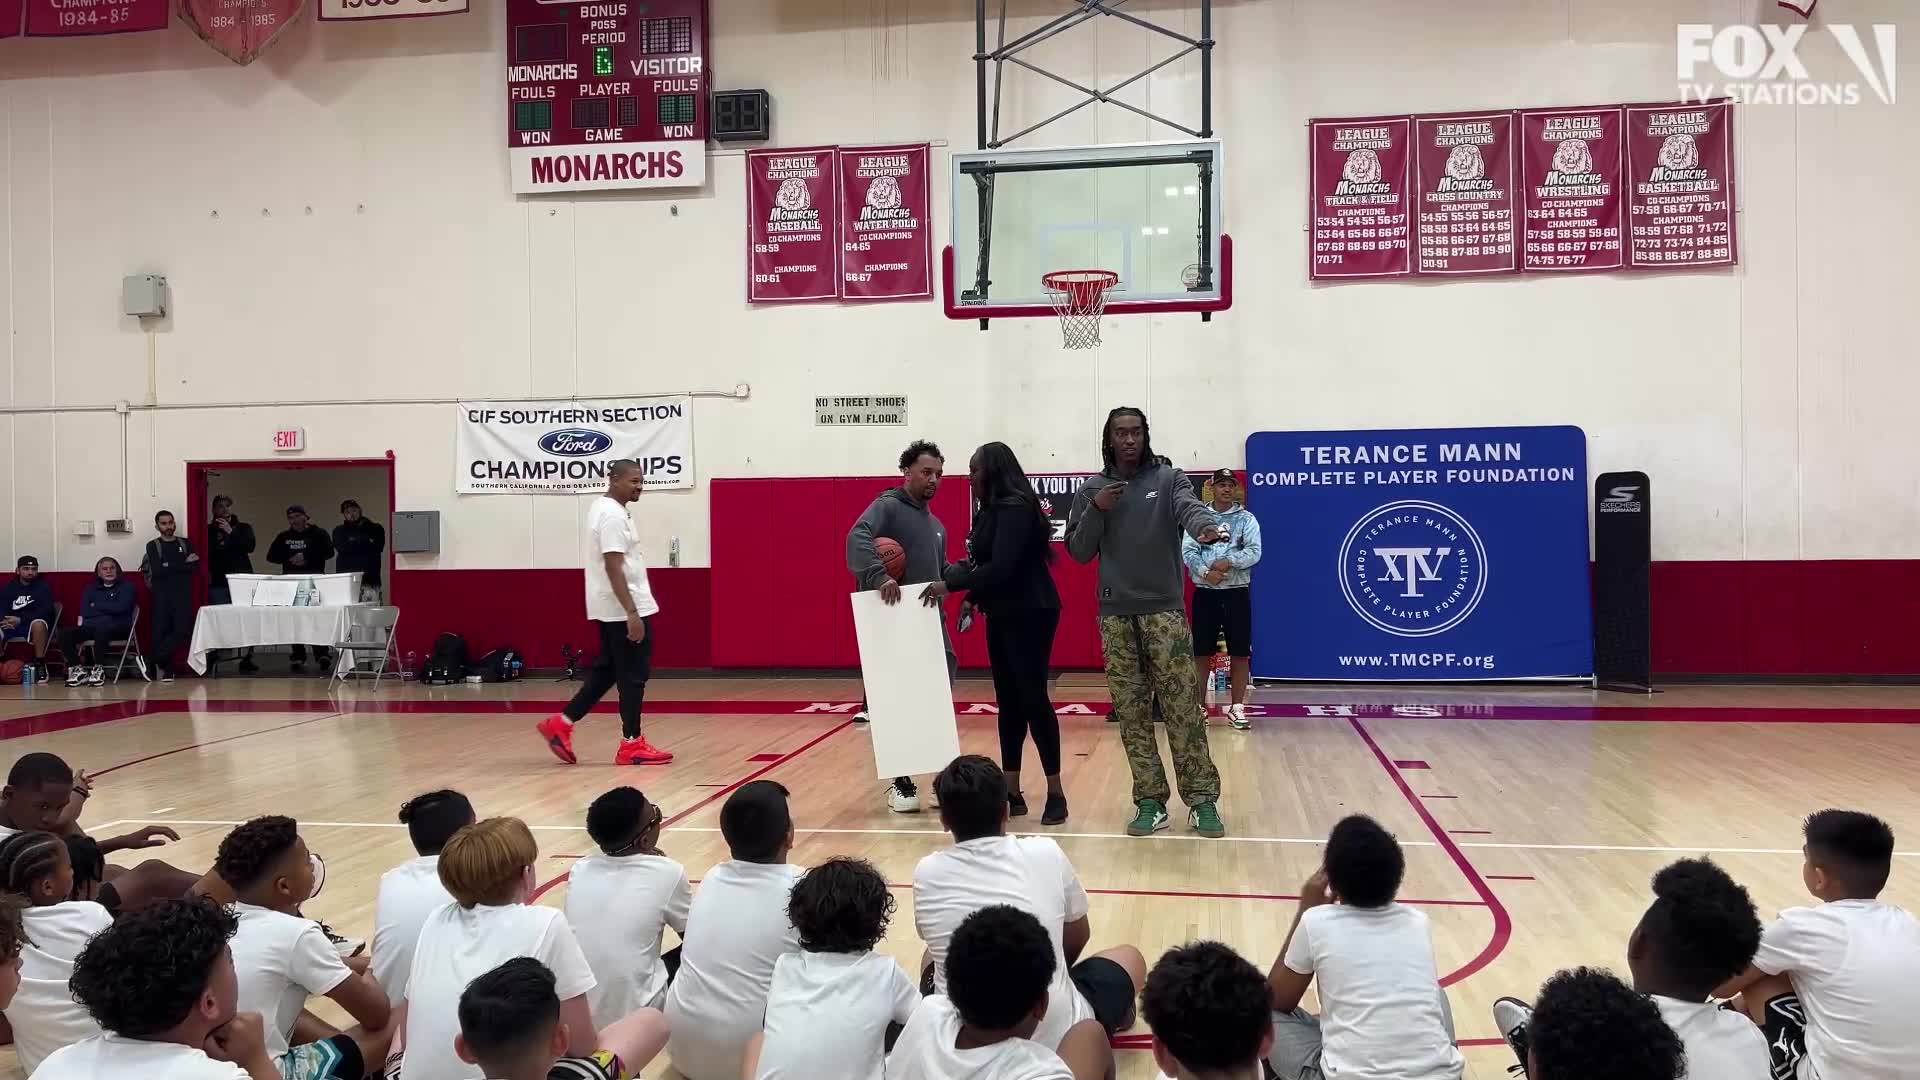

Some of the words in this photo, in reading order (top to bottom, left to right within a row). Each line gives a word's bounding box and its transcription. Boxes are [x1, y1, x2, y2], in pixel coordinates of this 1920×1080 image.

[580, 4, 627, 18] BONUS
[210, 16, 234, 28] 1984
[251, 13, 275, 26] 1985
[590, 20, 617, 31] POSS
[581, 32, 626, 45] PERIOD
[508, 63, 578, 82] MONARCHS
[630, 57, 701, 76] VISITOR
[579, 82, 631, 97] PLAYER
[653, 79, 699, 93] FOULS
[511, 86, 556, 99] FOULS
[1545, 117, 1599, 129] LEAGUE
[1650, 112, 1705, 125] LEAGUE
[585, 128, 623, 141] GAME
[663, 125, 694, 139] WON
[1336, 128, 1388, 140] LEAGUE
[1438, 123, 1491, 135] LEAGUE
[1543, 130, 1602, 140] CHAMPIONS
[1648, 124, 1708, 135] CHAMPIONS
[521, 130, 551, 145] WON
[1436, 135, 1493, 145] CHAMPIONS
[1334, 140, 1391, 150] CHAMPIONS
[531, 150, 684, 184] MONARCHS
[769, 157, 816, 169] LEAGUE
[860, 156, 908, 168] LEAGUE
[767, 169, 818, 179] CHAMPIONS
[857, 167, 909, 177] CHAMPIONS
[1650, 166, 1707, 182] MONARCHS
[1437, 177, 1493, 192] MONARCHS
[1545, 171, 1602, 186] MONARCHS
[1335, 181, 1390, 195] MONARCHS
[1536, 184, 1609, 198] WRESTLING
[1638, 180, 1718, 194] BASKETBALL
[1326, 196, 1358, 205] TRACK
[1361, 196, 1368, 204] &
[1371, 194, 1398, 204] FIELD
[1427, 192, 1456, 201] CROSS
[1458, 190, 1503, 200] COUNTRY
[860, 206, 910, 220] MONARCHS
[1337, 208, 1386, 217] CHAMPIONS
[1441, 203, 1489, 211] CHAMPIONS
[1558, 208, 1587, 218] 64-65
[1632, 205, 1660, 214] 57-58
[1663, 204, 1693, 213] 66-67
[1697, 201, 1726, 212] 70-71
[769, 207, 819, 221] MONARCHS
[1317, 217, 1344, 226] 53-54
[1347, 216, 1375, 225] 54-55
[1378, 214, 1405, 225] 56-57
[1421, 213, 1448, 222] 54-55
[1451, 212, 1479, 220] 55-56
[1482, 210, 1510, 219] 56-57
[1653, 215, 1704, 225] CHAMPIONS
[767, 220, 821, 232] BASEBALL
[854, 220, 889, 231] WATER
[892, 219, 917, 229] POLO
[1421, 225, 1448, 233] 58-59
[1451, 224, 1480, 232] 63-64
[1482, 221, 1511, 231] 64-65
[1547, 219, 1598, 228] CHAMPIONS
[1633, 226, 1660, 235] 58-59
[1663, 225, 1693, 235] 67-68
[1698, 222, 1727, 233] 71-72
[1317, 230, 1345, 239] 63-64
[1348, 229, 1376, 238] 65-66
[1378, 227, 1406, 237] 66-67
[1421, 236, 1449, 245] 65-66
[1451, 235, 1479, 244] 66-67
[1483, 233, 1511, 243] 67-68
[1527, 230, 1554, 239] 57-58
[1557, 229, 1586, 238] 58-59
[1589, 228, 1618, 237] 59-60
[845, 242, 871, 251] 64-65
[1317, 242, 1345, 251] 67-68
[1347, 241, 1376, 250] 68-69
[1378, 240, 1406, 250] 69-70
[1527, 243, 1555, 252] 65-66
[1558, 242, 1587, 251] 66-67
[1590, 241, 1619, 250] 67-68
[1634, 239, 1661, 248] 72-73
[1664, 238, 1693, 247] 73-74
[1697, 235, 1727, 246] 84-85
[755, 243, 779, 253] 58-59
[1451, 247, 1479, 256] 87-88
[1483, 244, 1511, 255] 89-90
[1317, 255, 1343, 264] 70-71
[1527, 255, 1554, 264] 74-75
[1557, 255, 1586, 264] 76-77
[1665, 250, 1694, 260] 86-87
[774, 265, 817, 273] CHAMPIONS
[865, 263, 908, 272] CHAMPIONS
[1422, 259, 1448, 268] 90-91
[755, 274, 780, 283] 60-61
[845, 273, 871, 282] 66-67
[816, 397, 828, 407] NO
[834, 397, 870, 407] STREET
[876, 397, 906, 407] SHOES
[468, 410, 496, 424] CIF
[499, 409, 599, 424] SOUTHERN
[602, 404, 682, 423] SECTION
[820, 414, 833, 423] ON
[839, 414, 860, 423] GYM
[866, 414, 902, 423] FLOOR.
[277, 431, 296, 447] EXIT
[552, 432, 597, 452] Ford
[1300, 444, 1428, 465] TERANCE
[1439, 443, 1522, 462] MANN
[1252, 470, 1356, 486] COMPLETE
[1363, 469, 1438, 486] PLAYER
[1446, 467, 1575, 484] FOUNDATION
[1042, 477, 1067, 494] YOU
[1600, 501, 1641, 509] SKECHERS
[1365, 515, 1419, 541] TERANCE
[1425, 518, 1458, 542] MANN
[1357, 549, 1381, 605] COMPLETE
[1384, 605, 1430, 619] PLAYER
[1435, 548, 1469, 613] FOUNDATION
[1338, 653, 1496, 670] www.TMCPF.org
